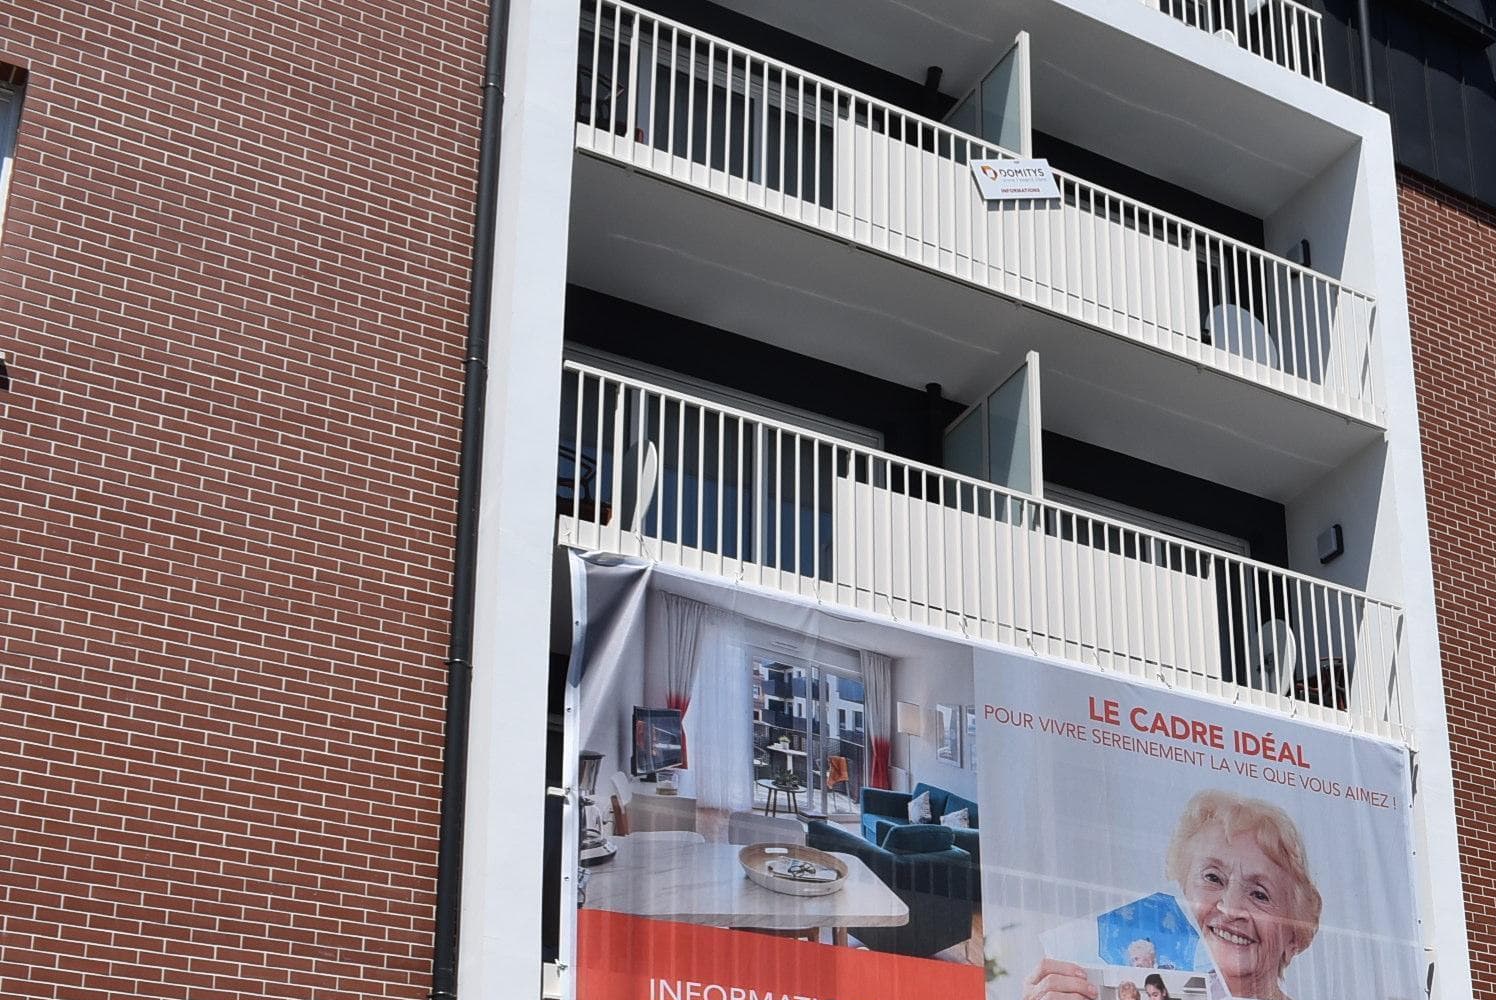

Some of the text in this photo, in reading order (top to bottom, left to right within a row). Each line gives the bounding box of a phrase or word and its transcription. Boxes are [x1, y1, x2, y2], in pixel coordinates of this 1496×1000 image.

[998, 168, 1045, 178] DOMITYS
[984, 704, 1034, 730] POUR
[1038, 716, 1087, 741] VIVRE
[1092, 729, 1205, 767] SEREINEMENT
[1210, 755, 1230, 773] LA
[1234, 760, 1257, 779] VIE
[1263, 767, 1296, 786] QUE
[1299, 775, 1341, 796] VOUS
[1345, 786, 1389, 808] AIMEZ
[1088, 696, 1311, 769] LE CADRE IDÉAL
